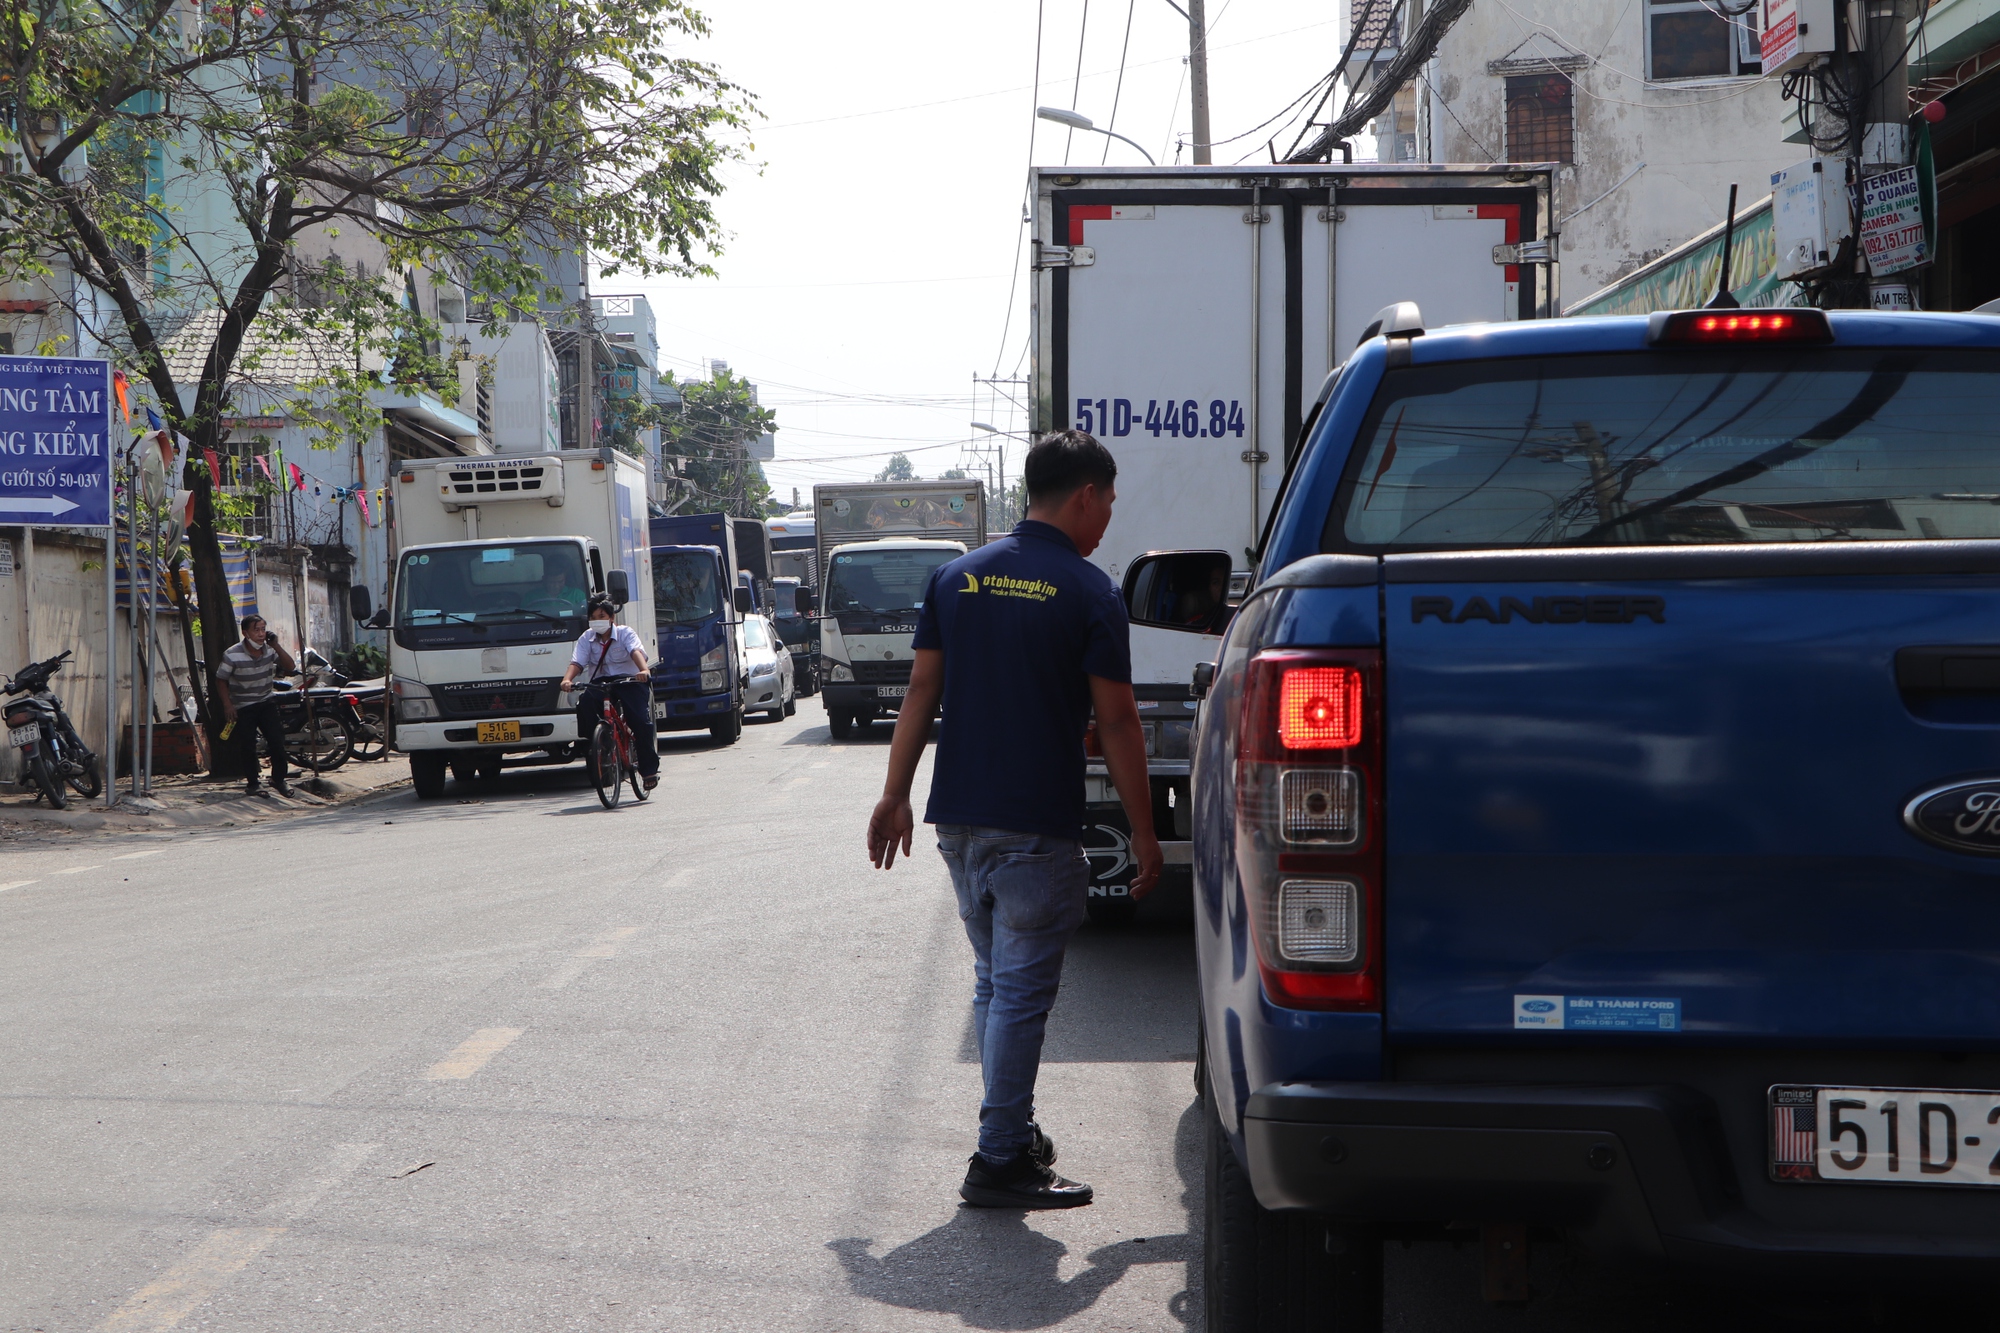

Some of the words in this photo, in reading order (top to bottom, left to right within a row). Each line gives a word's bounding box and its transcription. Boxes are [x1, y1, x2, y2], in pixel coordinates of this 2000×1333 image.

[1878, 182, 1918, 202] QUANG
[1862, 202, 1894, 219] RUYỀN
[1896, 196, 1919, 210] HÌNH
[1860, 212, 1900, 232] CAMERA
[1865, 225, 1923, 255] 092.151.7777
[1874, 291, 1890, 305] ẤM
[13, 361, 43, 373] KIỂM
[46, 364, 72, 375] VIỆT
[74, 367, 99, 375] NAM
[0, 388, 38, 413] NG
[44, 383, 100, 413] TÂM
[1076, 399, 1245, 438] 51D-446.84
[33, 420, 100, 456] KIỂM
[2, 467, 35, 487] GIỚI
[38, 466, 56, 487] SỐ
[59, 473, 101, 488] 50-03V
[983, 575, 1057, 597] otohoangkim
[1411, 595, 1666, 624] RANGER
[444, 681, 512, 690] MITUBISHI
[489, 722, 508, 732] 51C
[482, 732, 516, 742] 254.88
[1088, 885, 1128, 897] NO
[1528, 1002, 1549, 1011] Ford
[1596, 999, 1640, 1009] THÀNH
[1642, 1001, 1674, 1009] FORD
[1519, 1015, 1546, 1024] Quality
[1778, 1089, 1813, 1098] limited
[1779, 1166, 1813, 1178] USA
